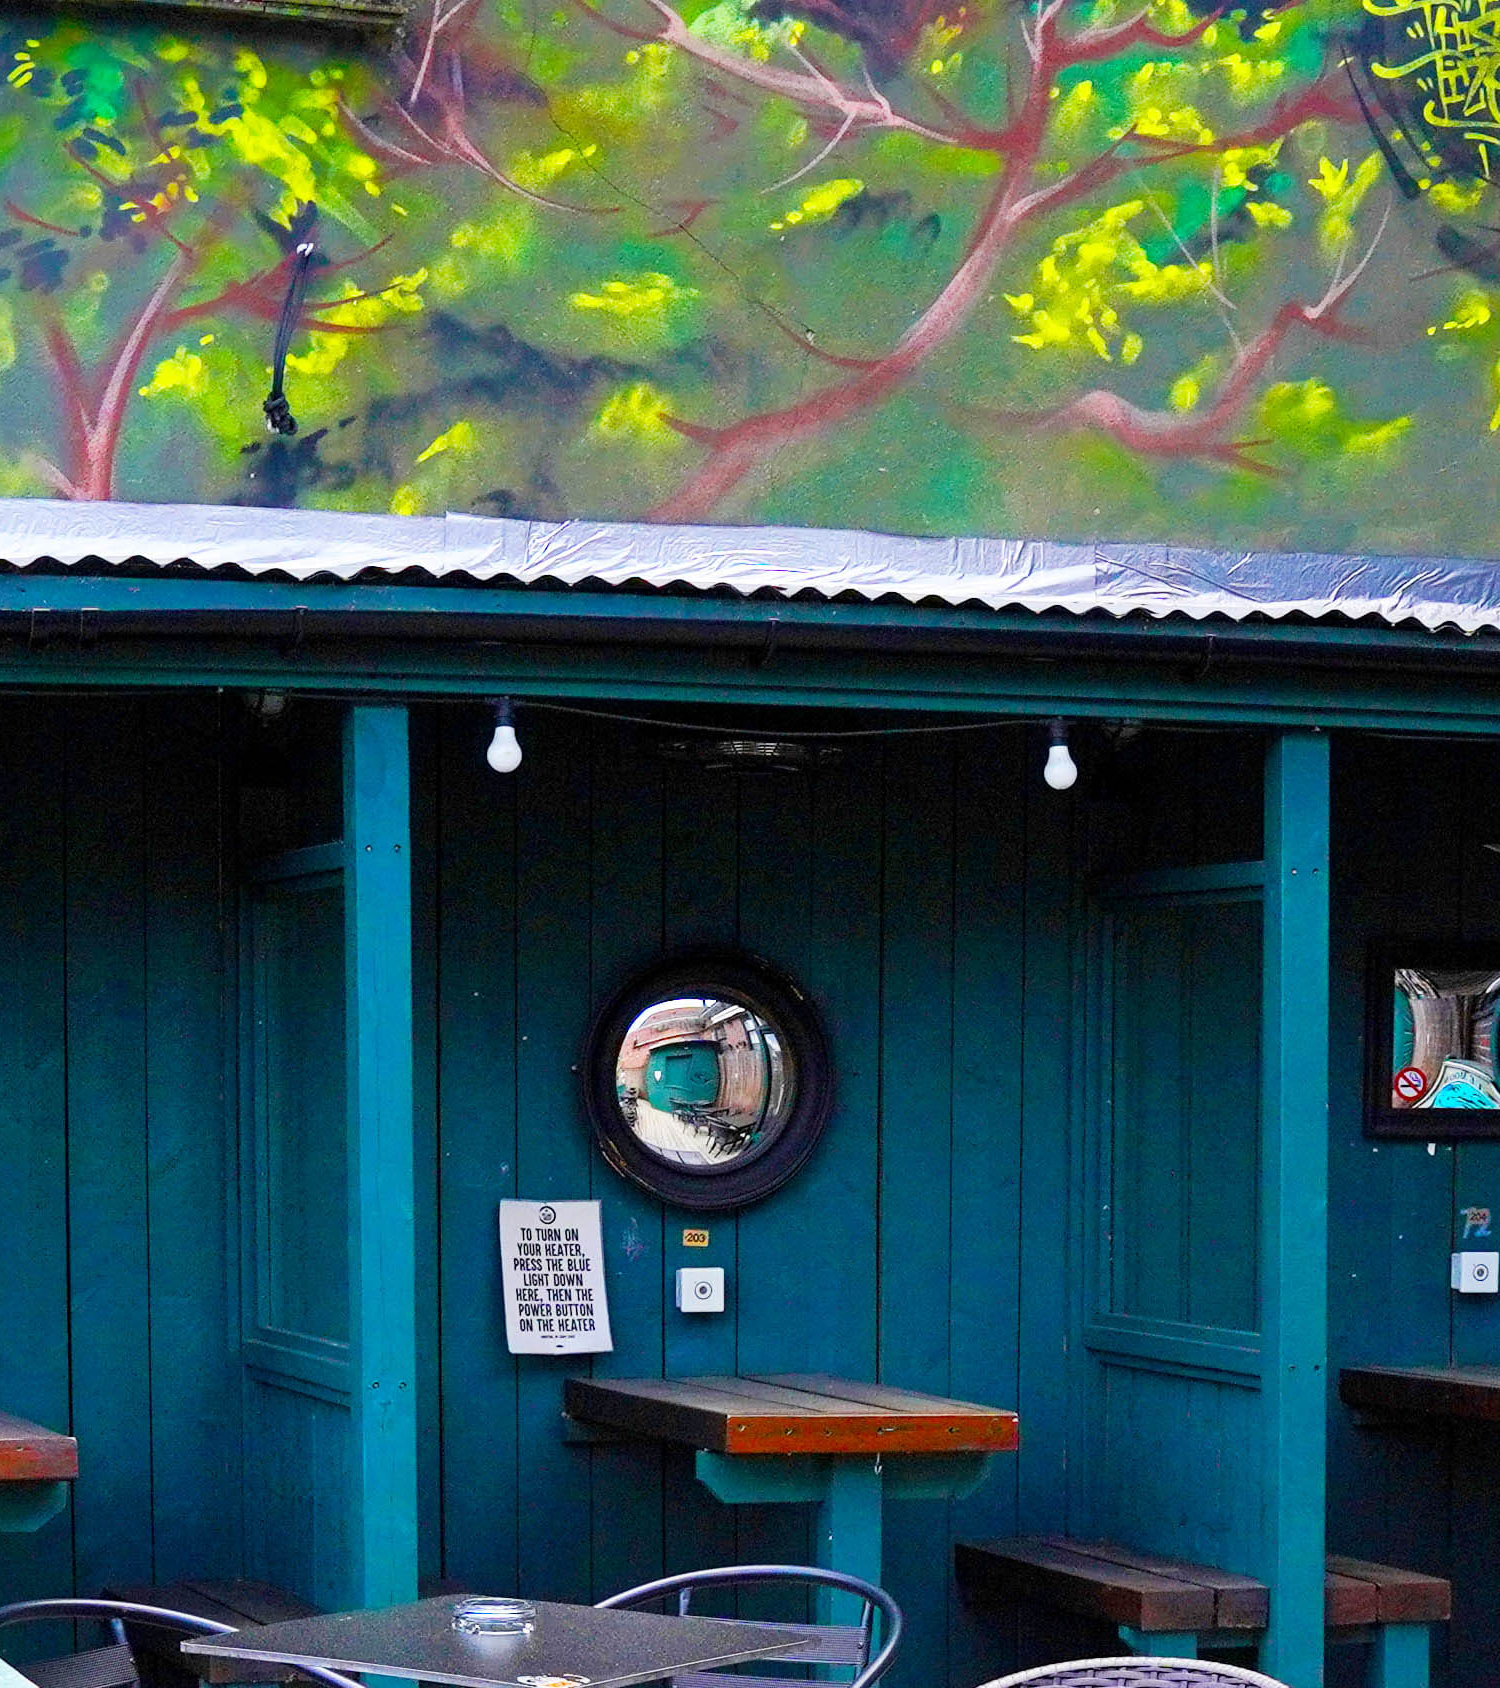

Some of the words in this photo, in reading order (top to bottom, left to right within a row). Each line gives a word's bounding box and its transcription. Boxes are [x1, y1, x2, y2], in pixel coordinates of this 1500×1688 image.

[520, 1227, 532, 1241] TO
[535, 1228, 561, 1242] TURN
[565, 1228, 579, 1242] ON
[687, 1232, 706, 1243] 203
[517, 1243, 542, 1257] YOUR
[545, 1243, 585, 1258] HEATER,
[513, 1258, 543, 1272] PRESS
[545, 1258, 564, 1272] THE
[567, 1258, 591, 1272] BLUE
[523, 1273, 549, 1287] LIGHT
[553, 1273, 583, 1287] DOWN
[516, 1288, 543, 1303] HERE,
[546, 1288, 572, 1302] THEN
[575, 1288, 594, 1302] THE
[518, 1303, 552, 1317] POWER
[555, 1303, 594, 1317] BUTTON
[519, 1319, 533, 1332] ON
[537, 1319, 555, 1332] THE
[558, 1318, 596, 1332] HEATER
